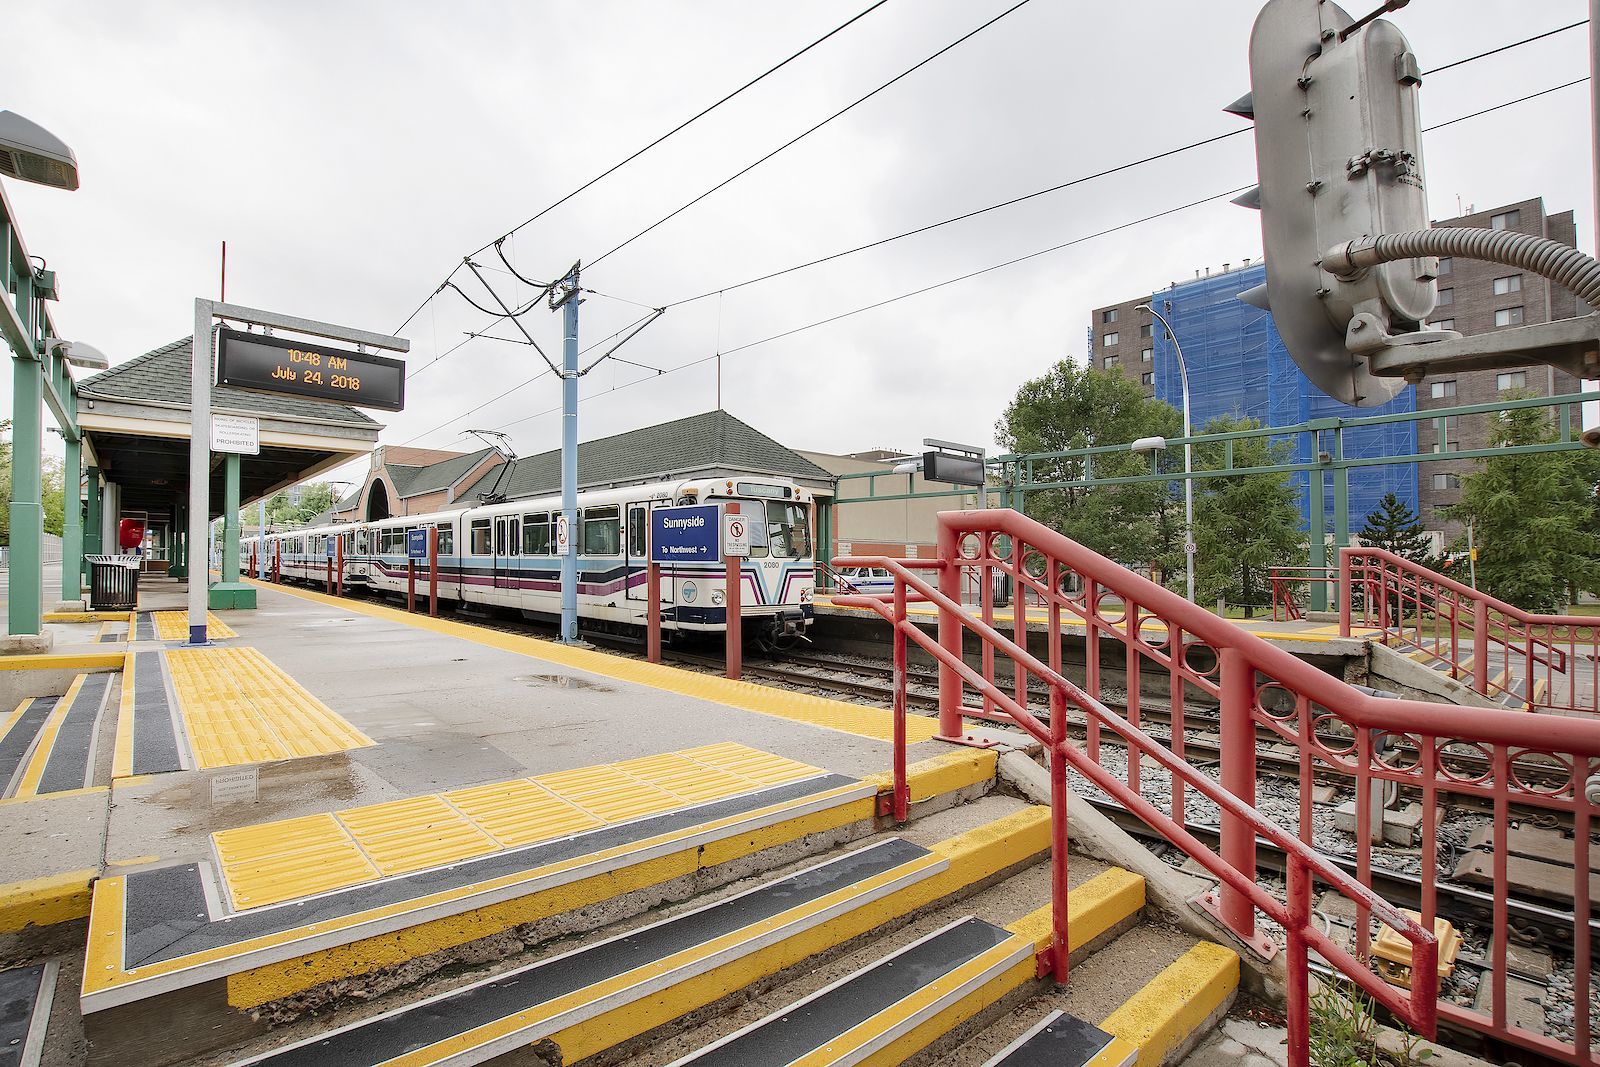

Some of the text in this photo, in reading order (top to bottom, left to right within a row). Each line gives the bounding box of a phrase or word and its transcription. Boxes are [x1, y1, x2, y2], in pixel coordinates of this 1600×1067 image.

[287, 348, 347, 371] 10:48 AM
[271, 365, 361, 391] July 24, 2018
[216, 438, 255, 447] PROHIBITED
[663, 515, 704, 530] Sunnyside
